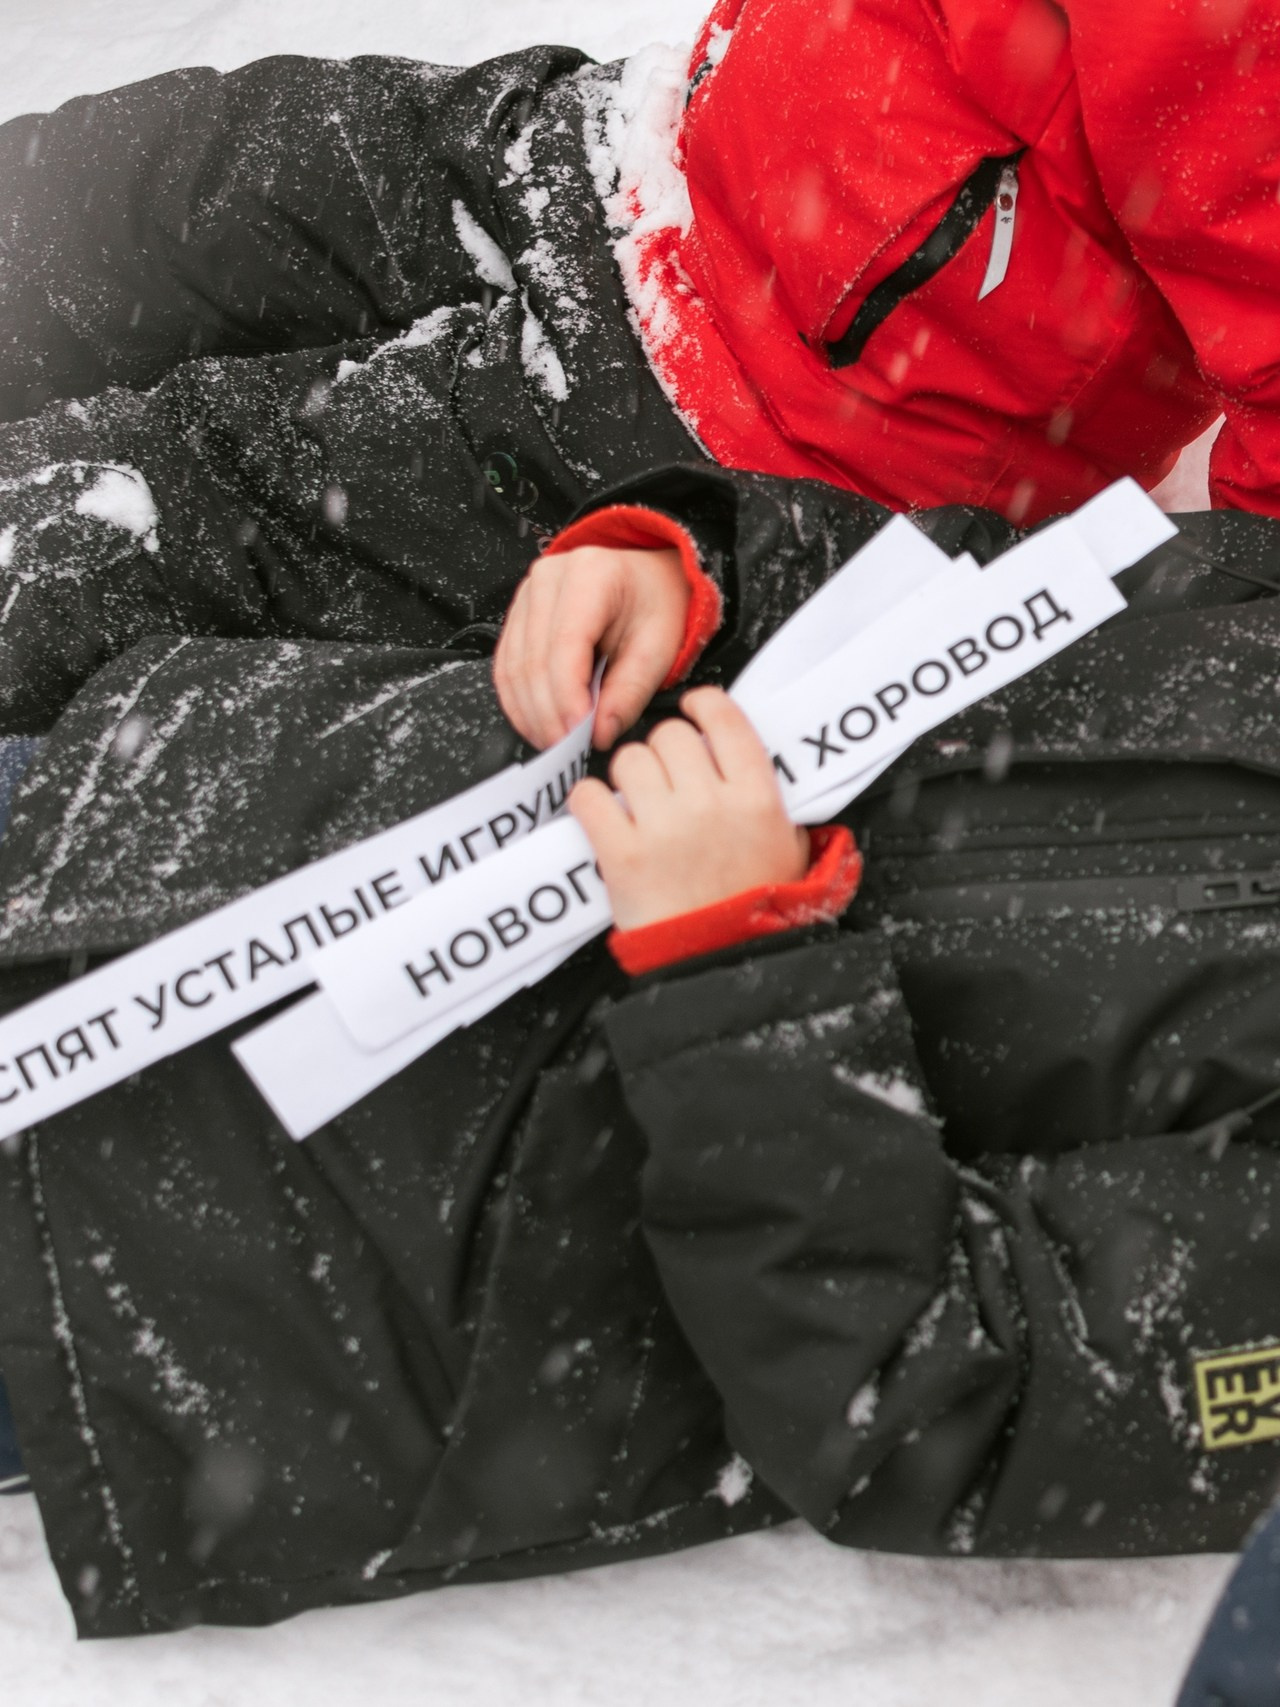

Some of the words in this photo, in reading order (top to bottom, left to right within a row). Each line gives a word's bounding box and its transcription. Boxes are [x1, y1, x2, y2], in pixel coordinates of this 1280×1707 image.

[405, 855, 606, 999] НОВОГ
[800, 588, 1074, 769] ХОРОВОД
[133, 868, 410, 1030] УСТАЛЫЕ
